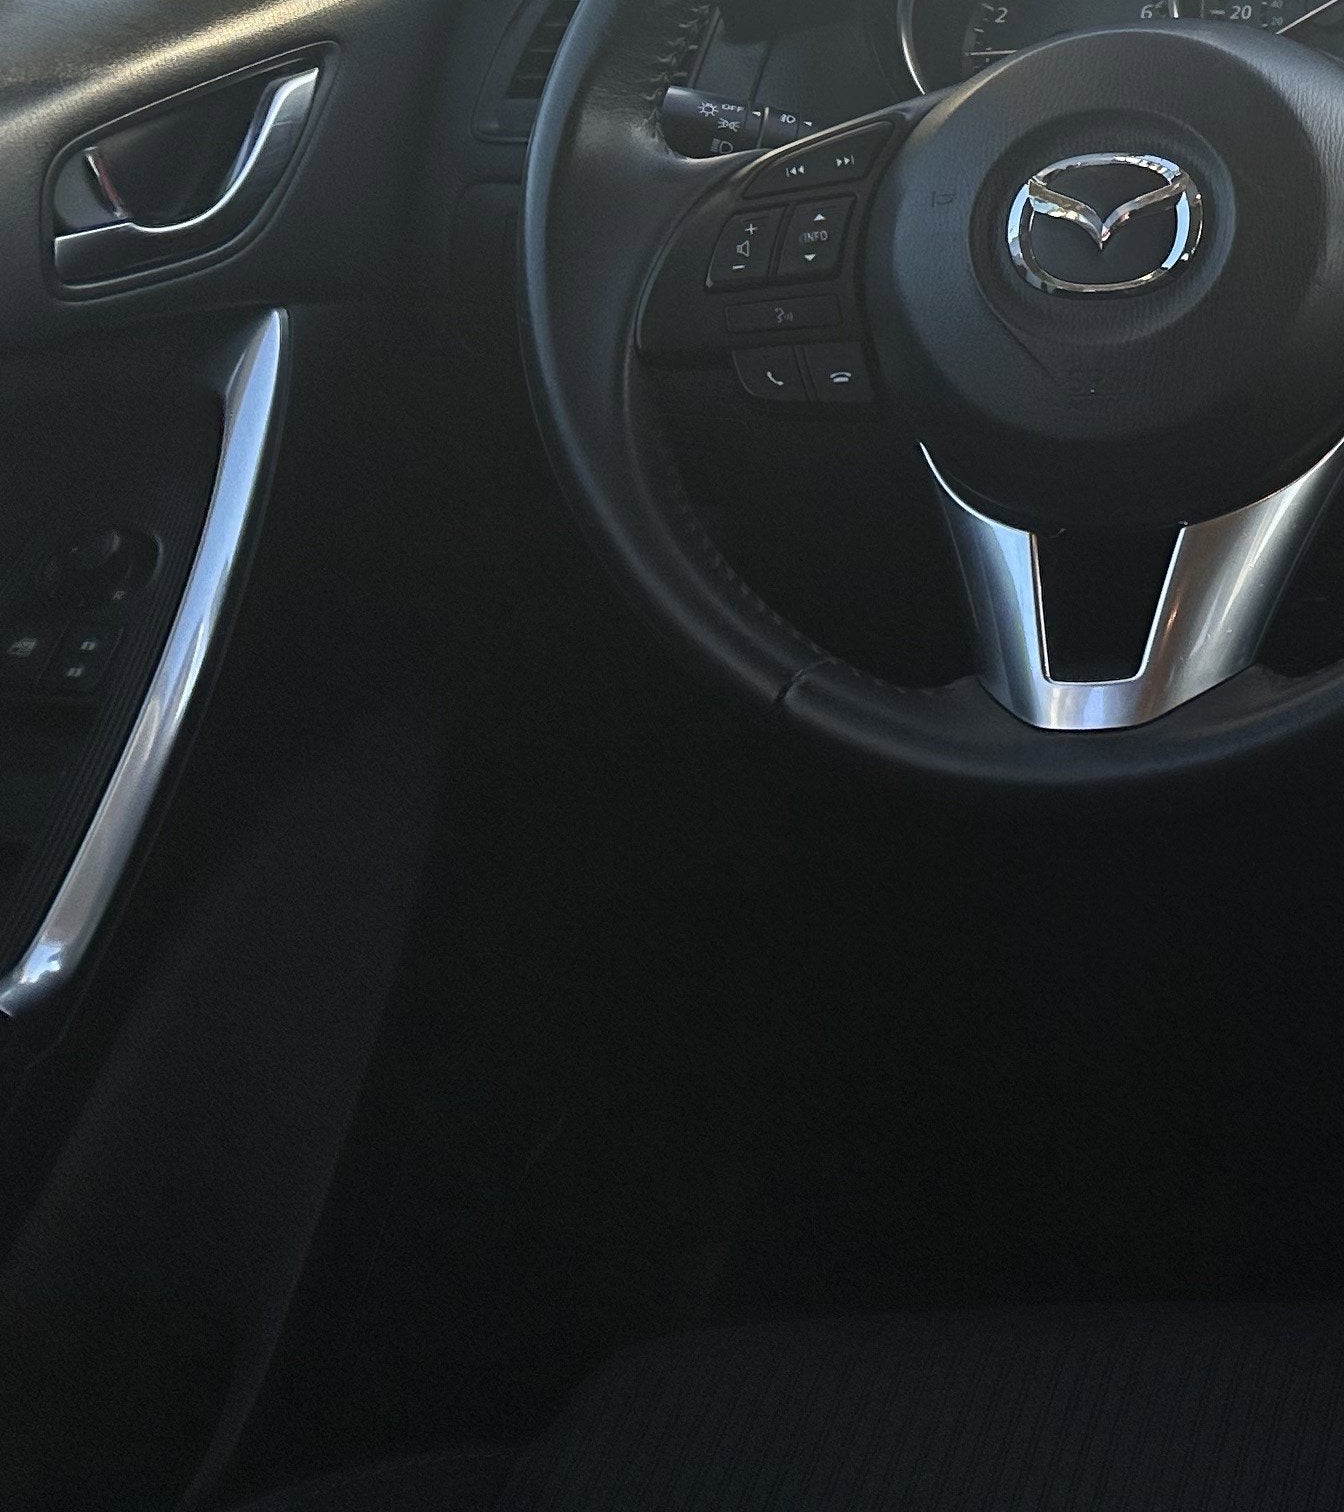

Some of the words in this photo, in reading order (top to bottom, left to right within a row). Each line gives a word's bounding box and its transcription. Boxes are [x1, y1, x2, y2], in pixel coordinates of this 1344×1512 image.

[1140, 3, 1153, 20] 6
[1229, 4, 1252, 20] 20
[1269, 0, 1283, 9] 40
[993, 7, 1009, 24] 2
[803, 230, 829, 243] INFO
